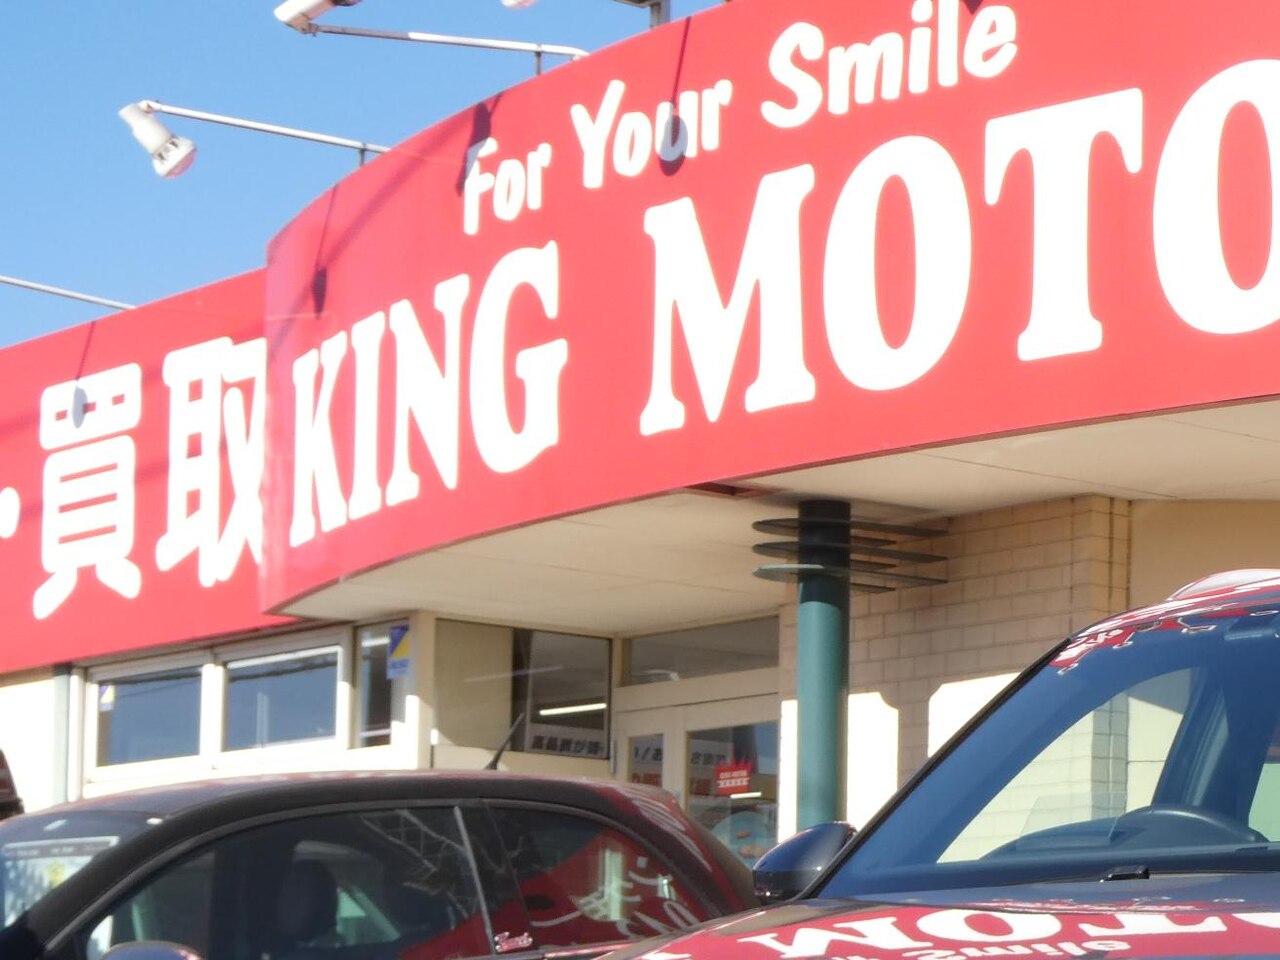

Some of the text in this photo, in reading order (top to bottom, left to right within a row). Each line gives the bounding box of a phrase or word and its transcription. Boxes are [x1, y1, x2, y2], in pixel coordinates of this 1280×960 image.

[463, 0, 1018, 236] For Your Smile
[289, 241, 568, 547] KING
